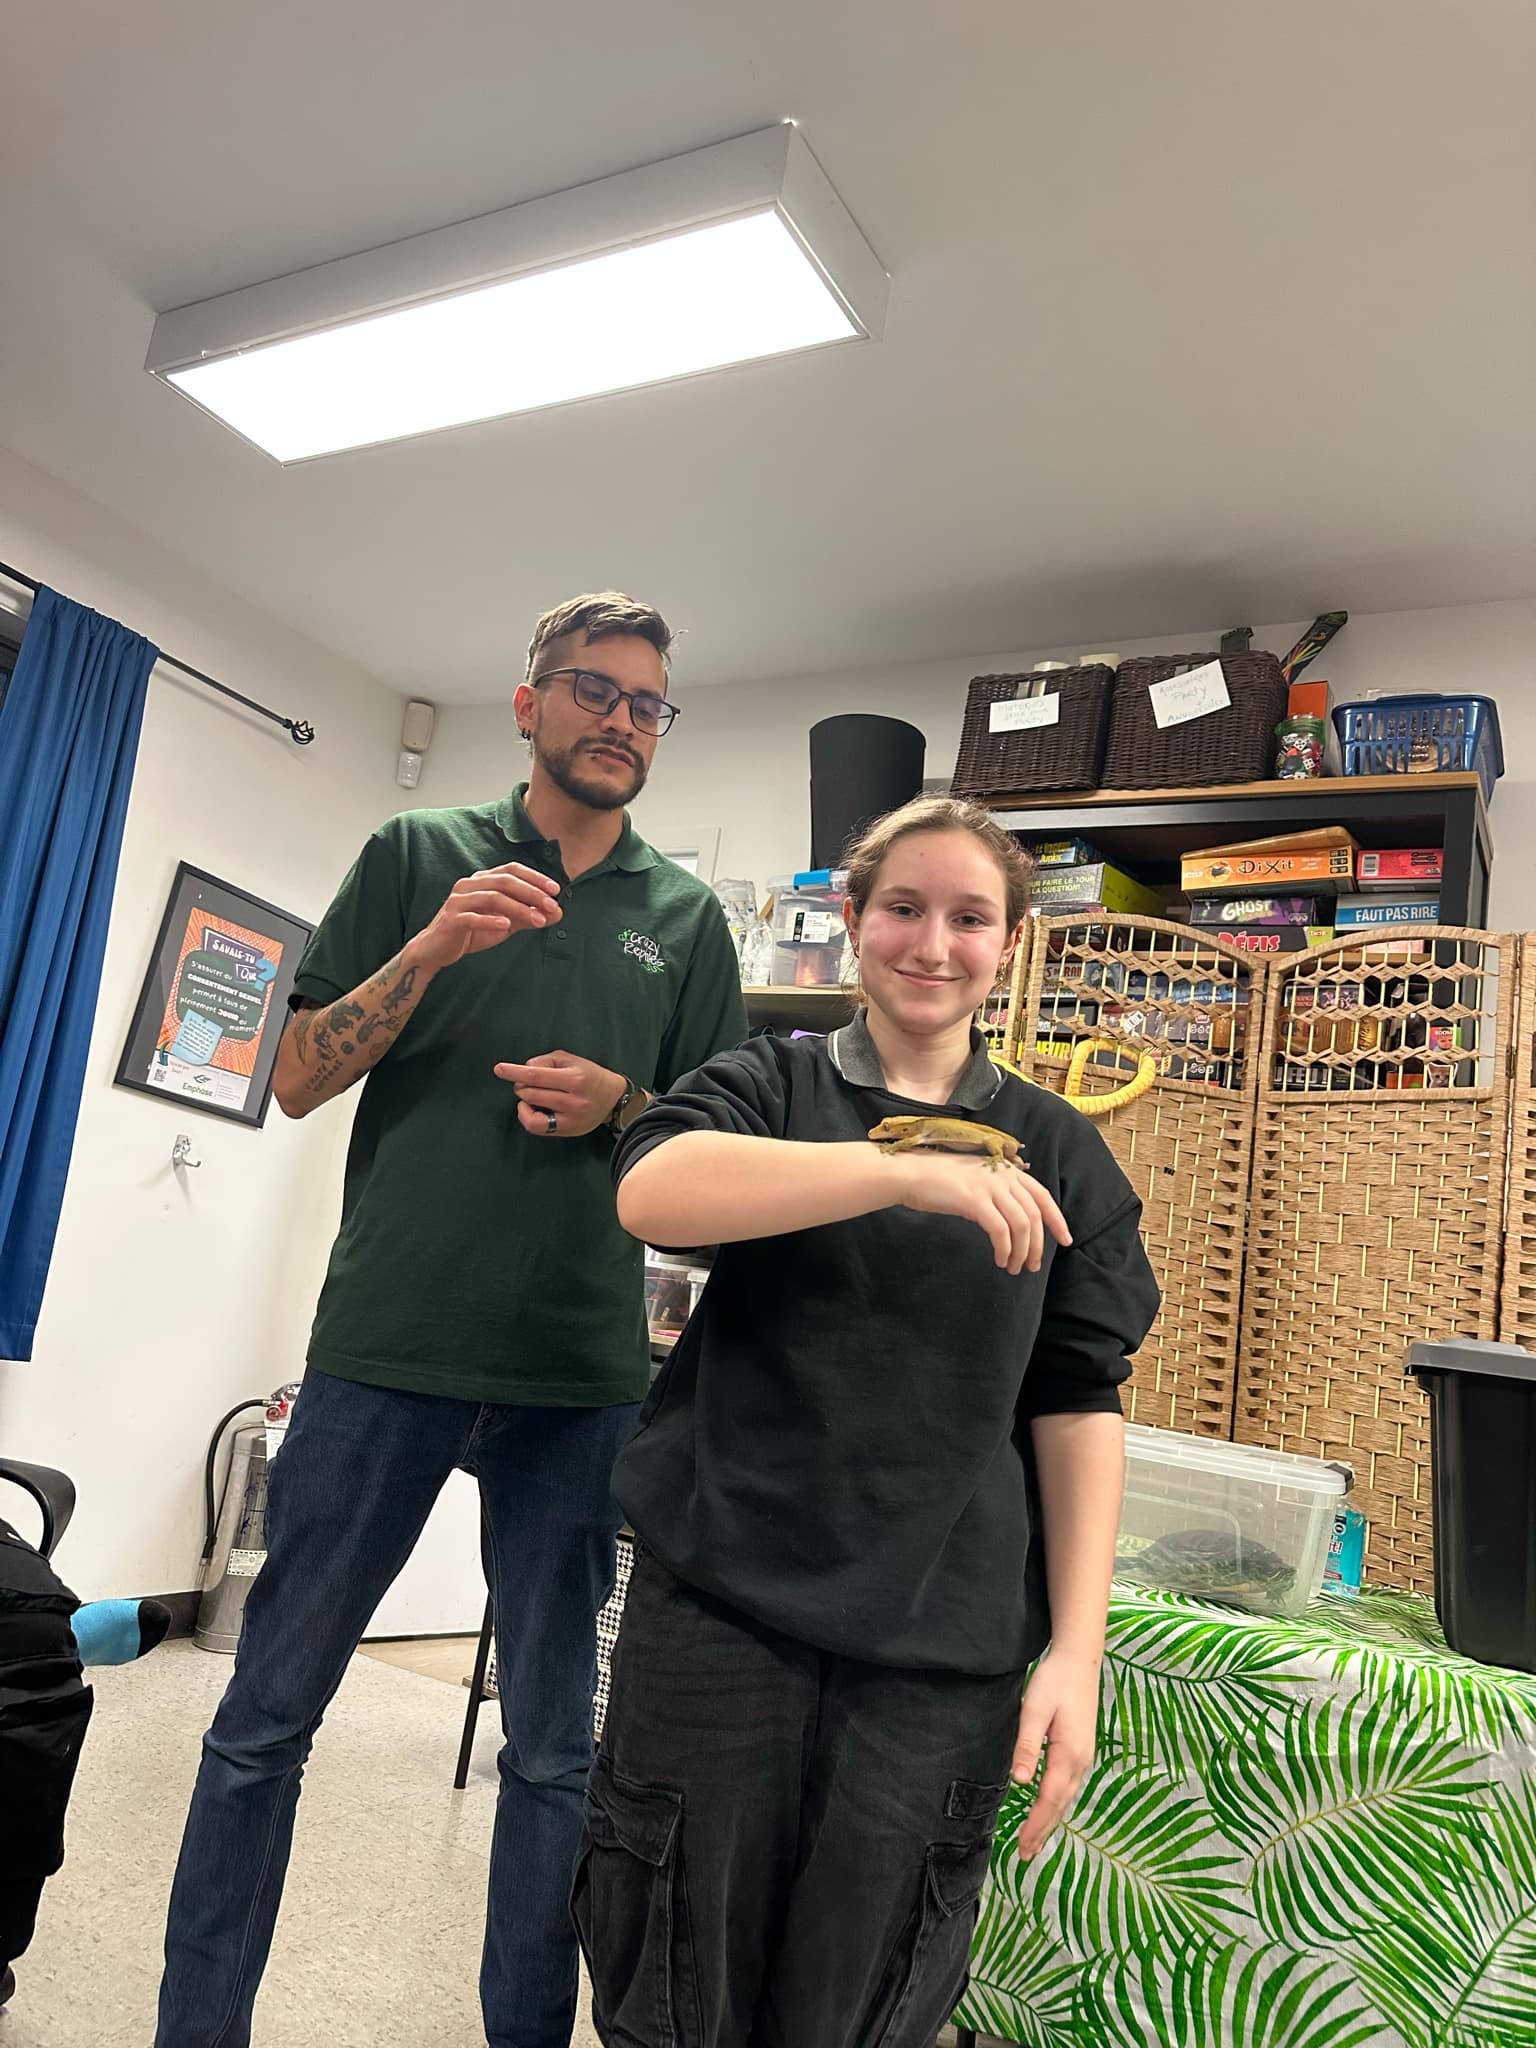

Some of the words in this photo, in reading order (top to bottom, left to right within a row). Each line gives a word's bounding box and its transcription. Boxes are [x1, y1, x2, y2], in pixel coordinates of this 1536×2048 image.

[1042, 878, 1062, 886] FAIRE
[1076, 875, 1095, 883] TOUR
[1221, 900, 1273, 922] GHOST
[1355, 908, 1384, 922] FAUT
[1385, 906, 1409, 920] PAS
[1410, 905, 1438, 919] RIRE
